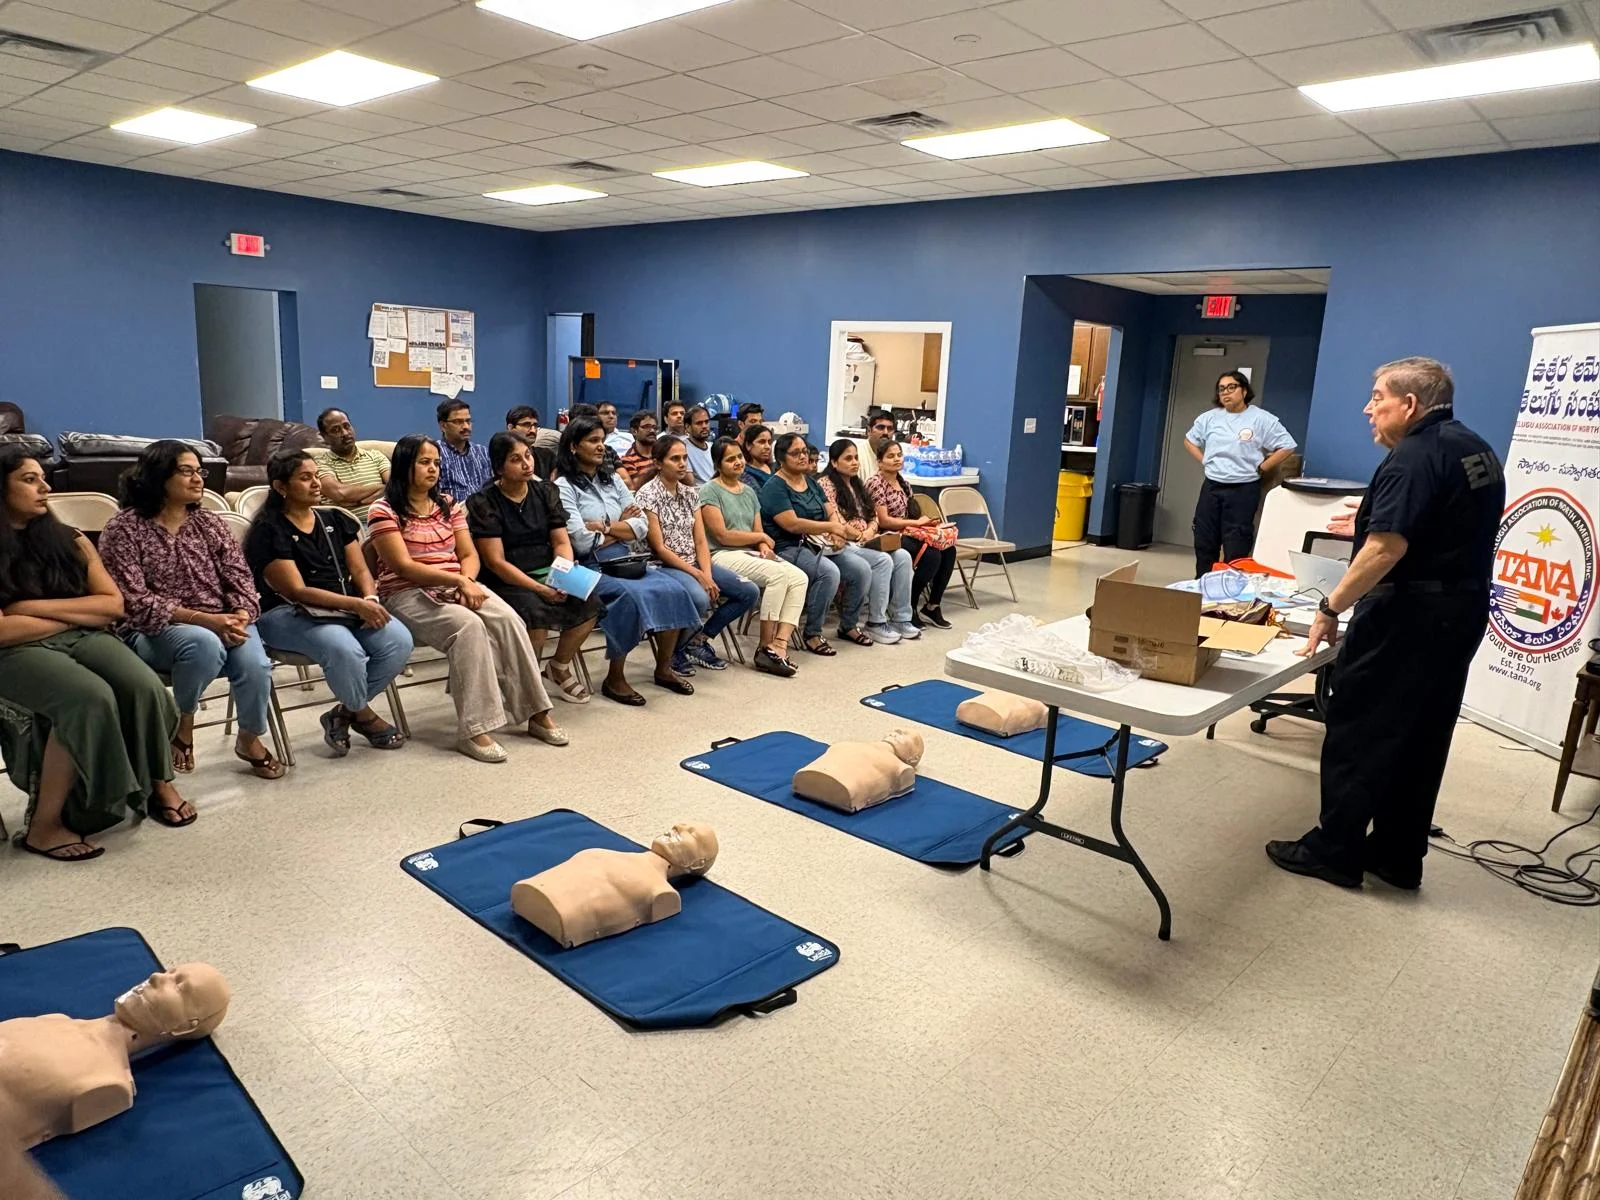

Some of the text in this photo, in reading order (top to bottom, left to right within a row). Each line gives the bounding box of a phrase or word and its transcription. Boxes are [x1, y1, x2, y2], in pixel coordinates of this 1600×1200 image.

[1535, 422, 1571, 432] ASSOCIATION
[1571, 424, 1579, 433] OF
[1578, 424, 1599, 434] NORTH
[1507, 498, 1548, 526] ASSOCIATION
[1549, 498, 1559, 507] OF
[1558, 499, 1577, 521] NORTH
[1496, 549, 1580, 601] TANA
[1485, 627, 1583, 664] Youth are Our Heritage
[1488, 663, 1542, 691] www.tana.org
[1500, 657, 1535, 676] Est. 1977
